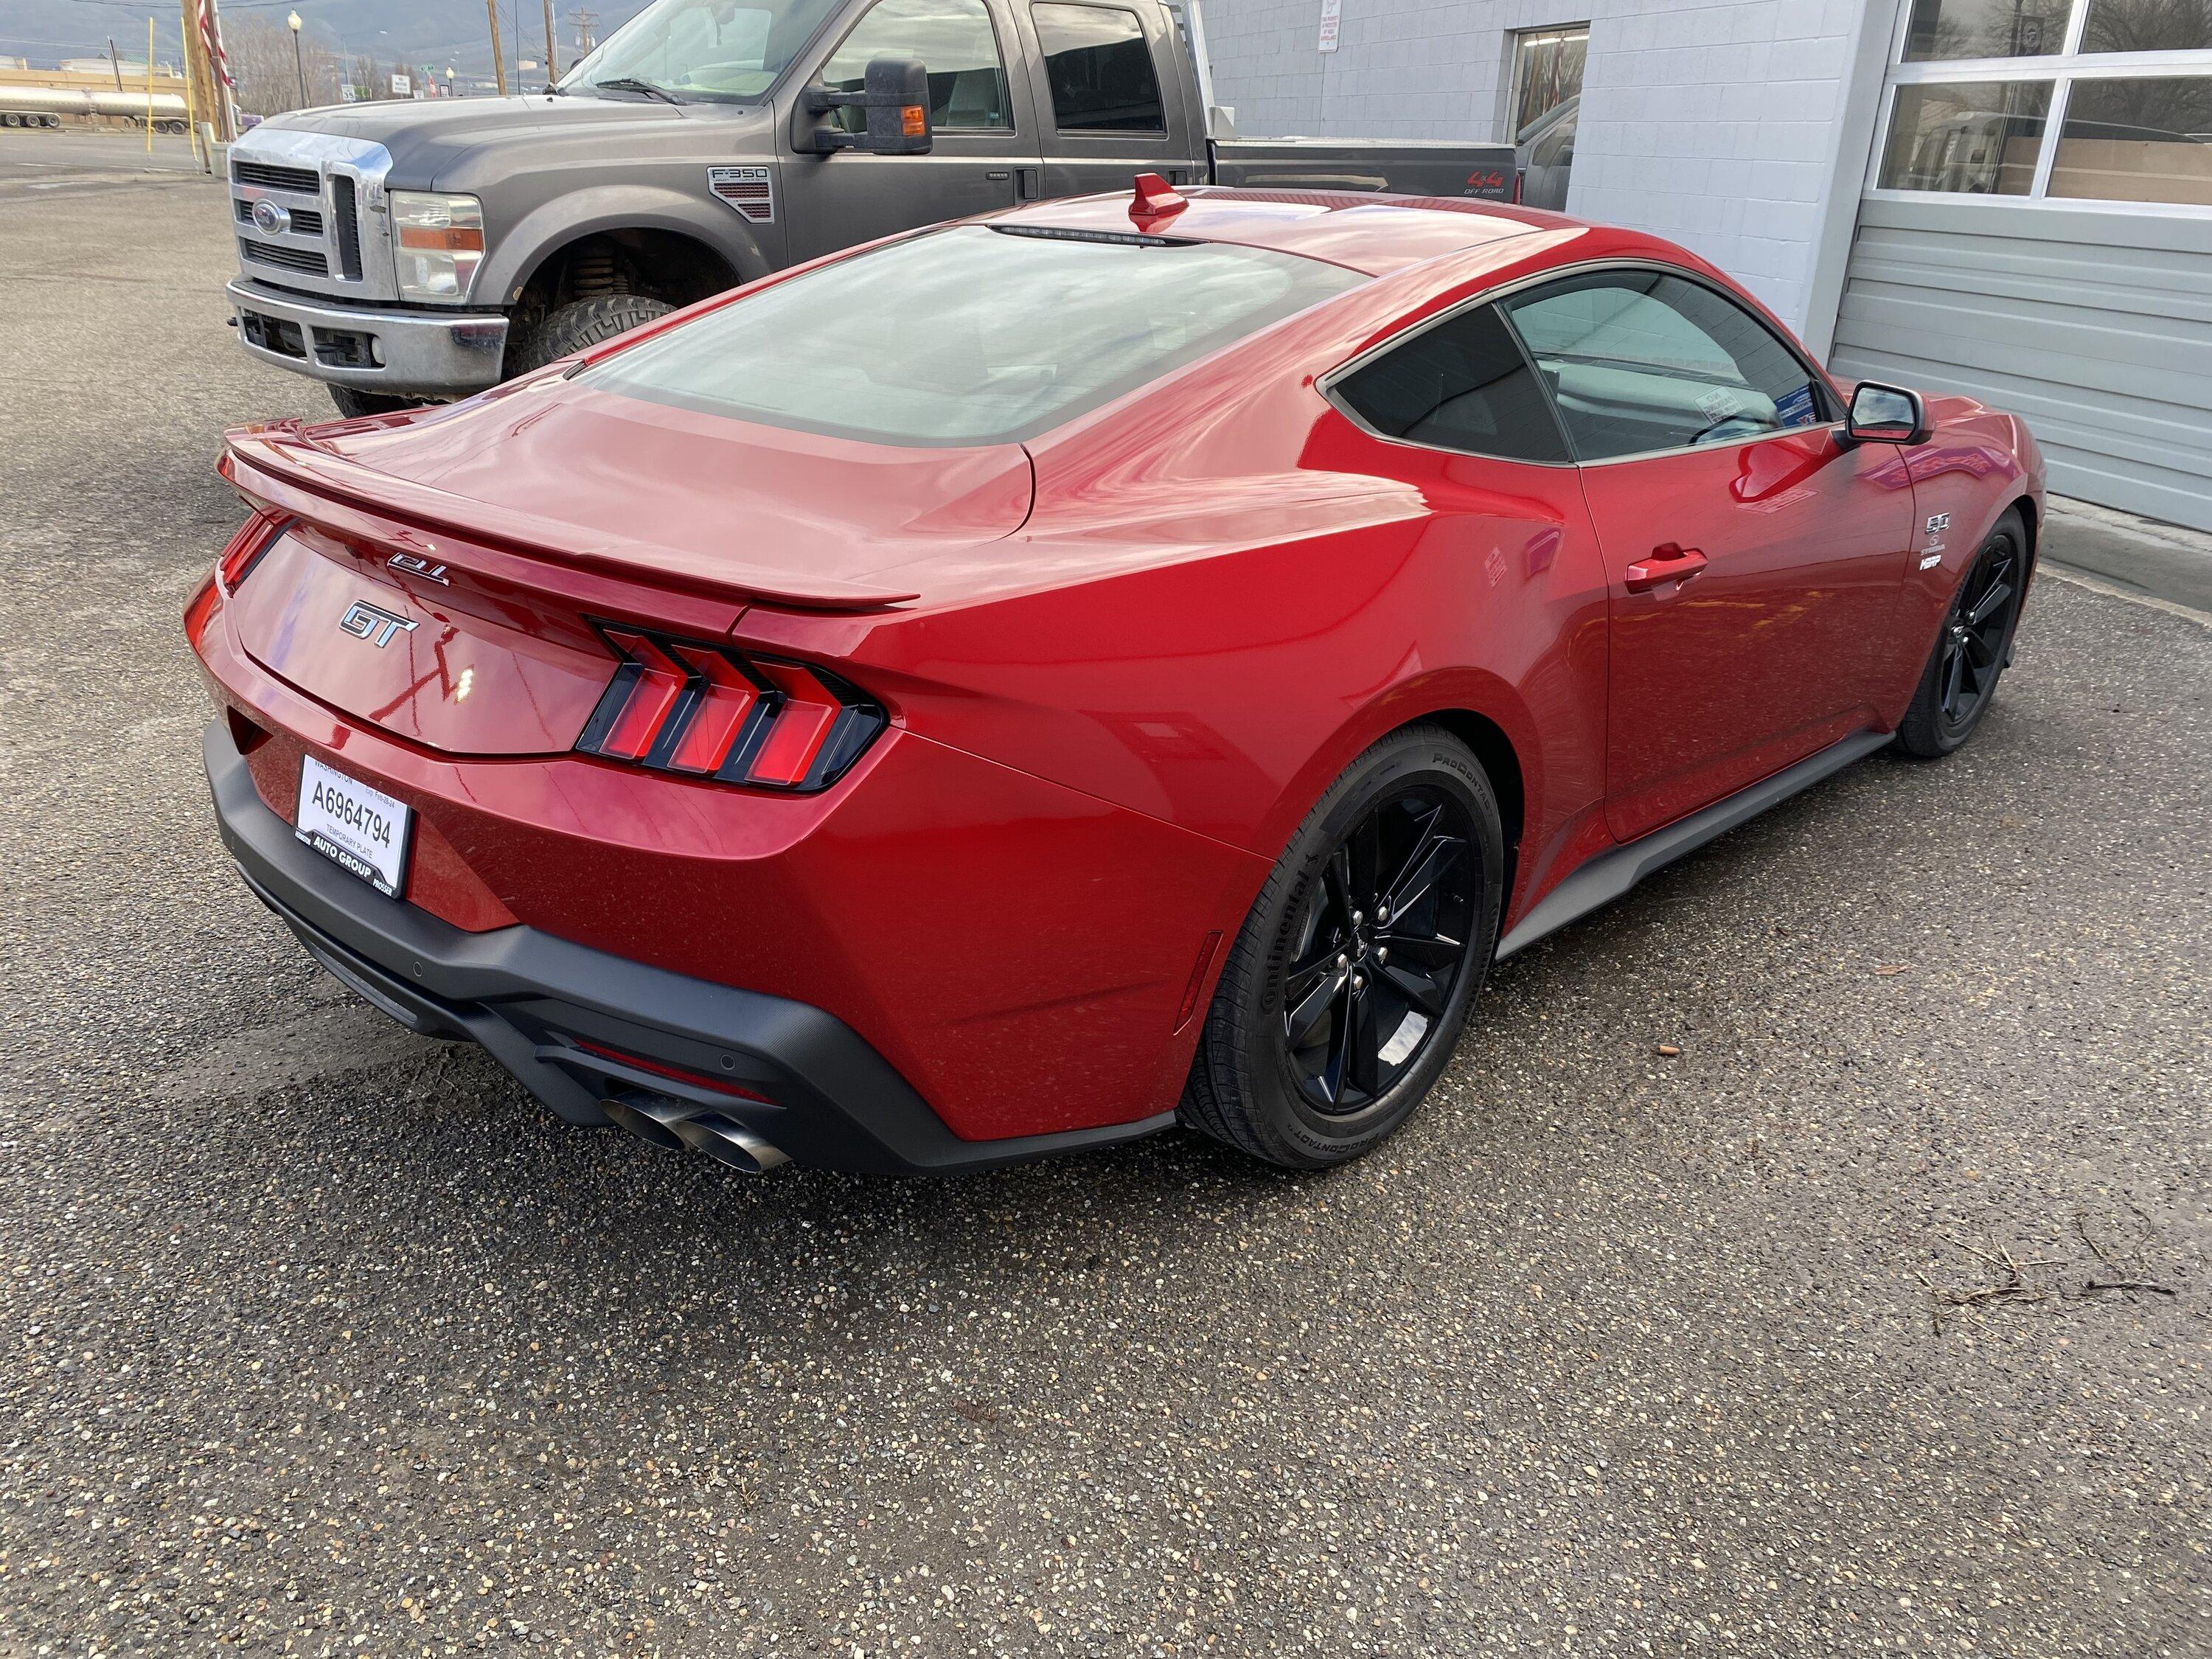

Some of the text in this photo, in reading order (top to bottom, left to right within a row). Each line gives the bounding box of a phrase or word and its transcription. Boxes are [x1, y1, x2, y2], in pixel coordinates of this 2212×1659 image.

[712, 169, 768, 178] F-350
[338, 599, 420, 648] GT
[311, 780, 391, 849] A6964794
[313, 836, 338, 858] AUTO
[338, 852, 372, 877] GROUP
[327, 824, 356, 847] TEMPORARY
[357, 843, 373, 859] PLATE
